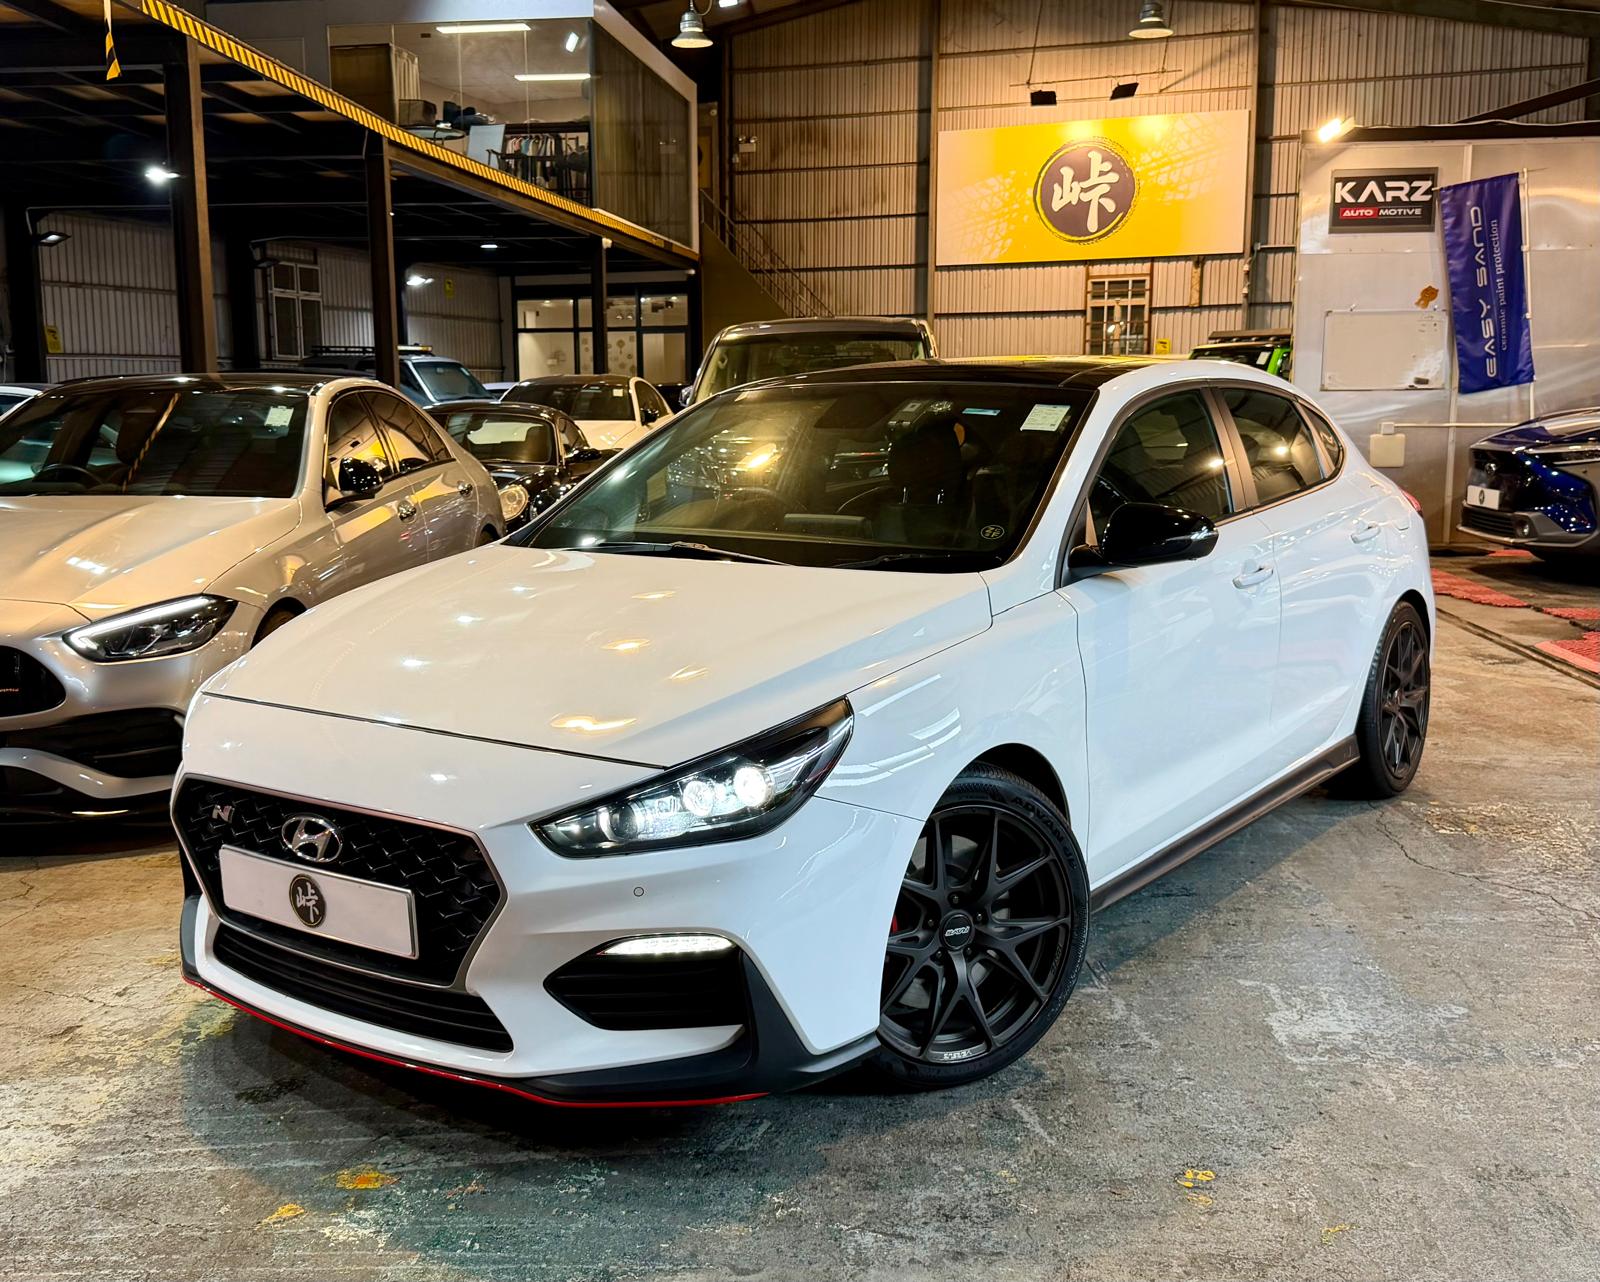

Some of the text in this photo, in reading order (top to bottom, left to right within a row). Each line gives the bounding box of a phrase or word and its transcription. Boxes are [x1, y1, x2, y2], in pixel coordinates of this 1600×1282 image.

[1051, 151, 1119, 233] 峠
[1335, 180, 1433, 203] KARZ
[1343, 208, 1422, 217] AUTO MOTIVE
[1491, 219, 1505, 275] protection
[1470, 206, 1497, 377] EASY SAND
[1496, 279, 1507, 306] paint
[212, 804, 235, 823] N
[296, 881, 319, 923] 峠
